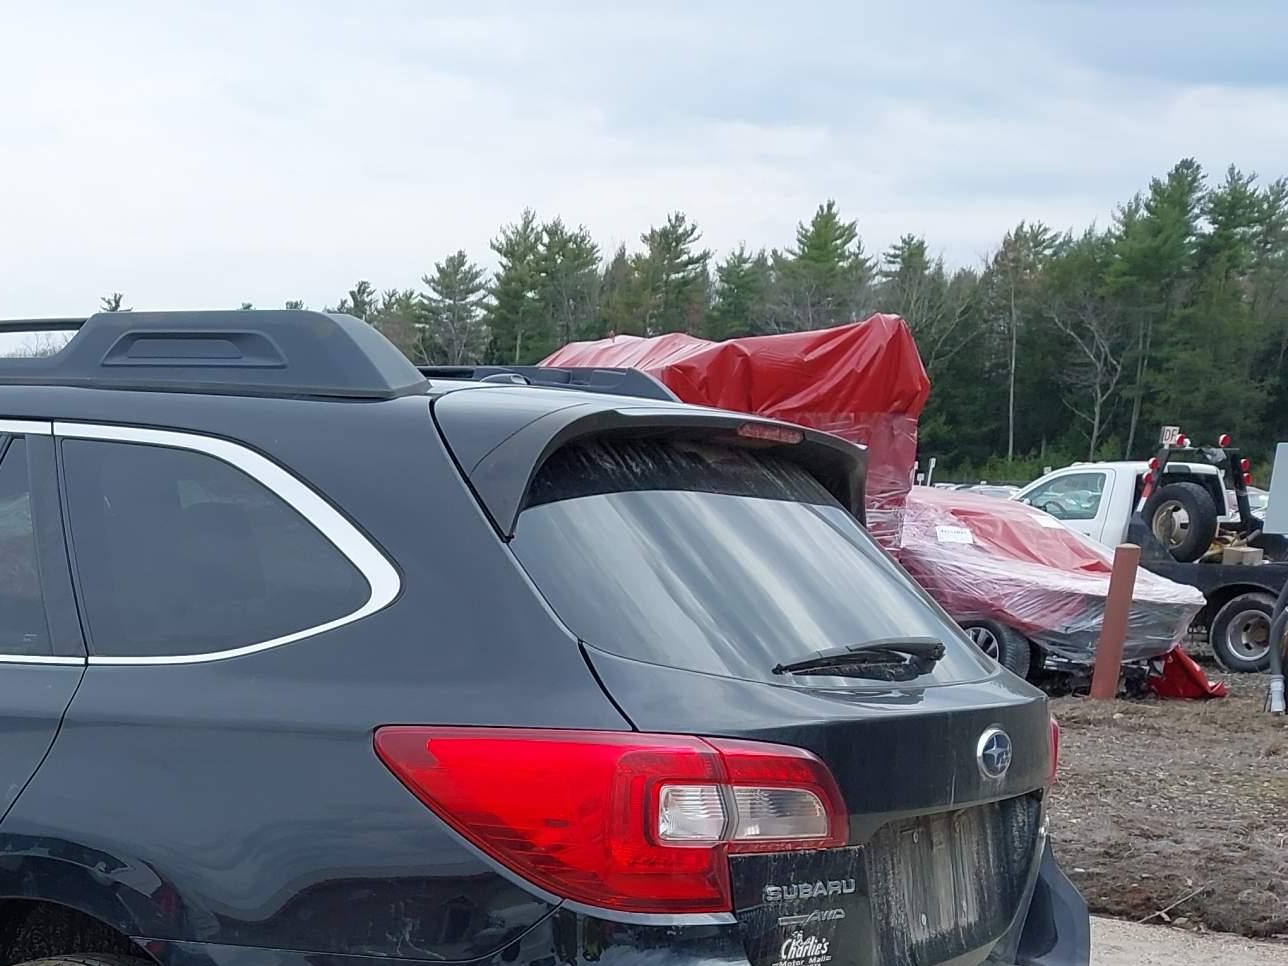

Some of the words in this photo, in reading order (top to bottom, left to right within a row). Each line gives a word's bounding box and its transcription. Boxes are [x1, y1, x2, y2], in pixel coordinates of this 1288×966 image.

[765, 879, 856, 901] SUBARU
[805, 908, 846, 924] AWD
[781, 935, 830, 960] Charlie's
[808, 955, 826, 963] Mall
